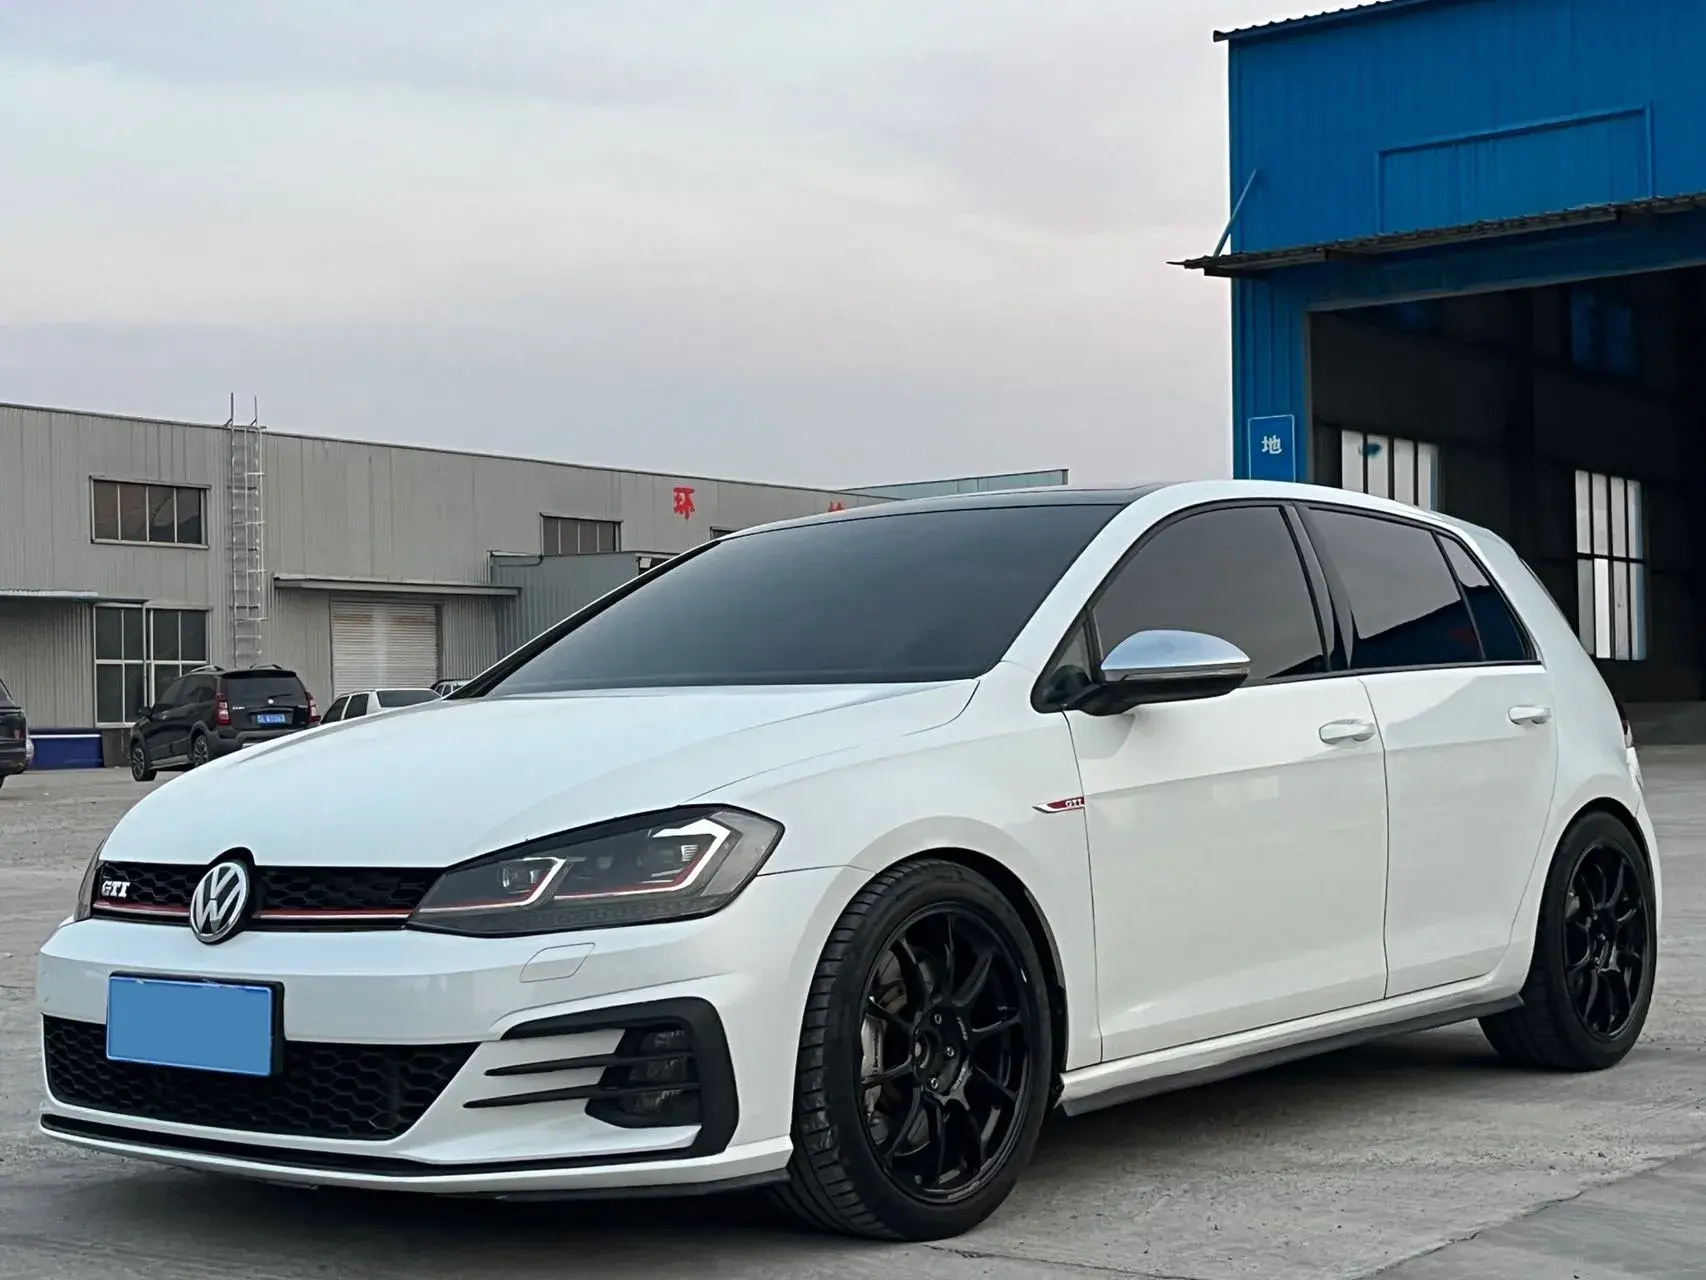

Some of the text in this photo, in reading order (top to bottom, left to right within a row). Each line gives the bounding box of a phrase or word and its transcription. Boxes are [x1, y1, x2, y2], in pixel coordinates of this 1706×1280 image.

[1261, 434, 1282, 454] 地
[673, 486, 695, 520] 环
[1065, 799, 1082, 807] GTI
[101, 880, 130, 897] GTI
